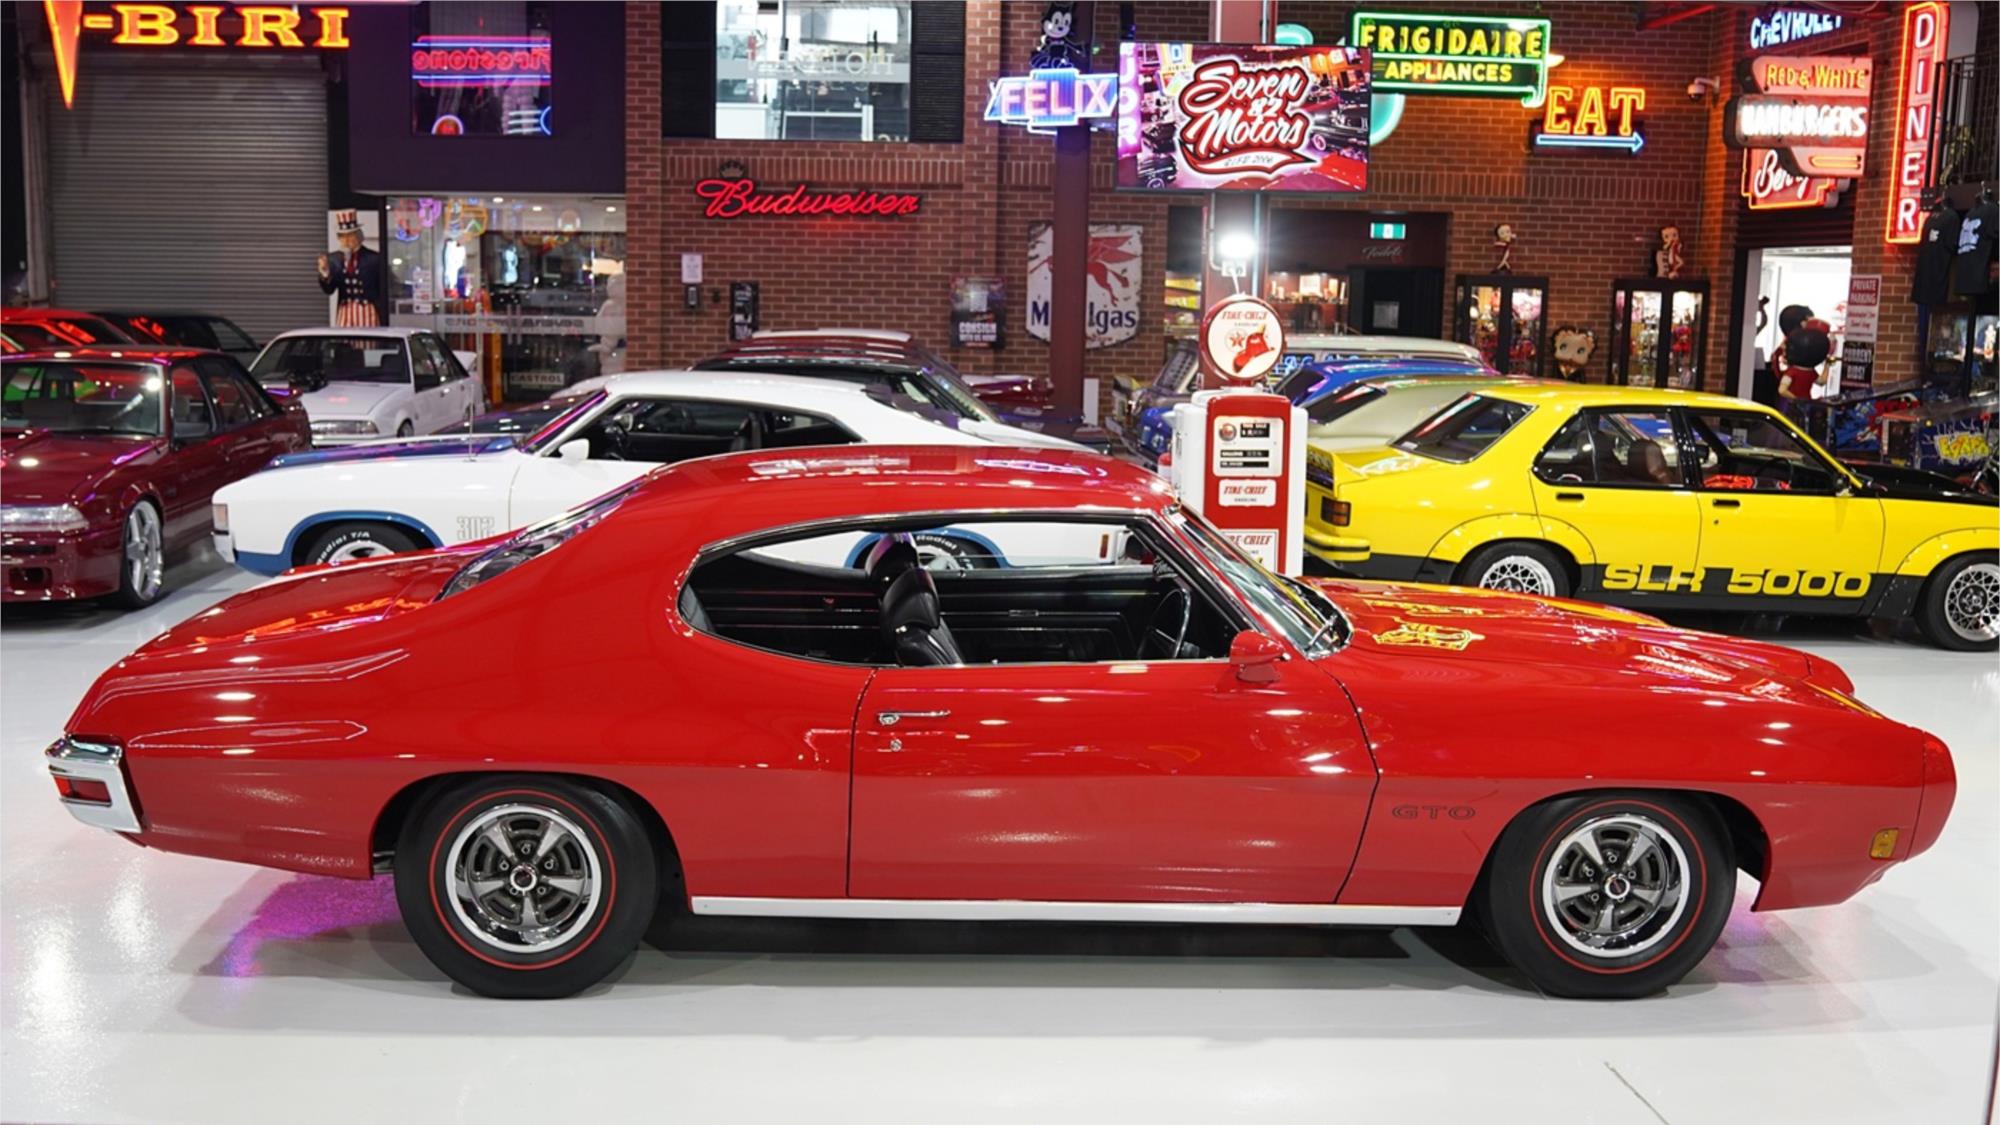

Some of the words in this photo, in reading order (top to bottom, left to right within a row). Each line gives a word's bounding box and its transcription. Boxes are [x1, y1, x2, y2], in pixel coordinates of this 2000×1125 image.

[1360, 25, 1543, 57] FRIGIDAIRE
[1186, 61, 1302, 113] Seven
[1384, 62, 1513, 82] APPLIANCES
[1768, 65, 1794, 86] RED
[1799, 70, 1809, 88] &
[1814, 65, 1866, 88] WHITE
[1001, 80, 1110, 115] FELIX
[1544, 86, 1645, 136] EAT
[1185, 108, 1302, 156] Motors
[1741, 104, 1868, 137] HAMBURGERS
[1897, 13, 1934, 232] DINER
[697, 179, 919, 217] Budweiser
[1850, 293, 1877, 305] PARKING
[1852, 280, 1877, 291] PRIVATE
[1031, 300, 1137, 335] Mlgas
[350, 531, 370, 539] T/A
[456, 516, 495, 541] 302
[916, 535, 957, 550] Radial
[1602, 563, 1706, 592] SLR
[1727, 567, 1872, 598] 5000
[1392, 805, 1476, 820] GTO
